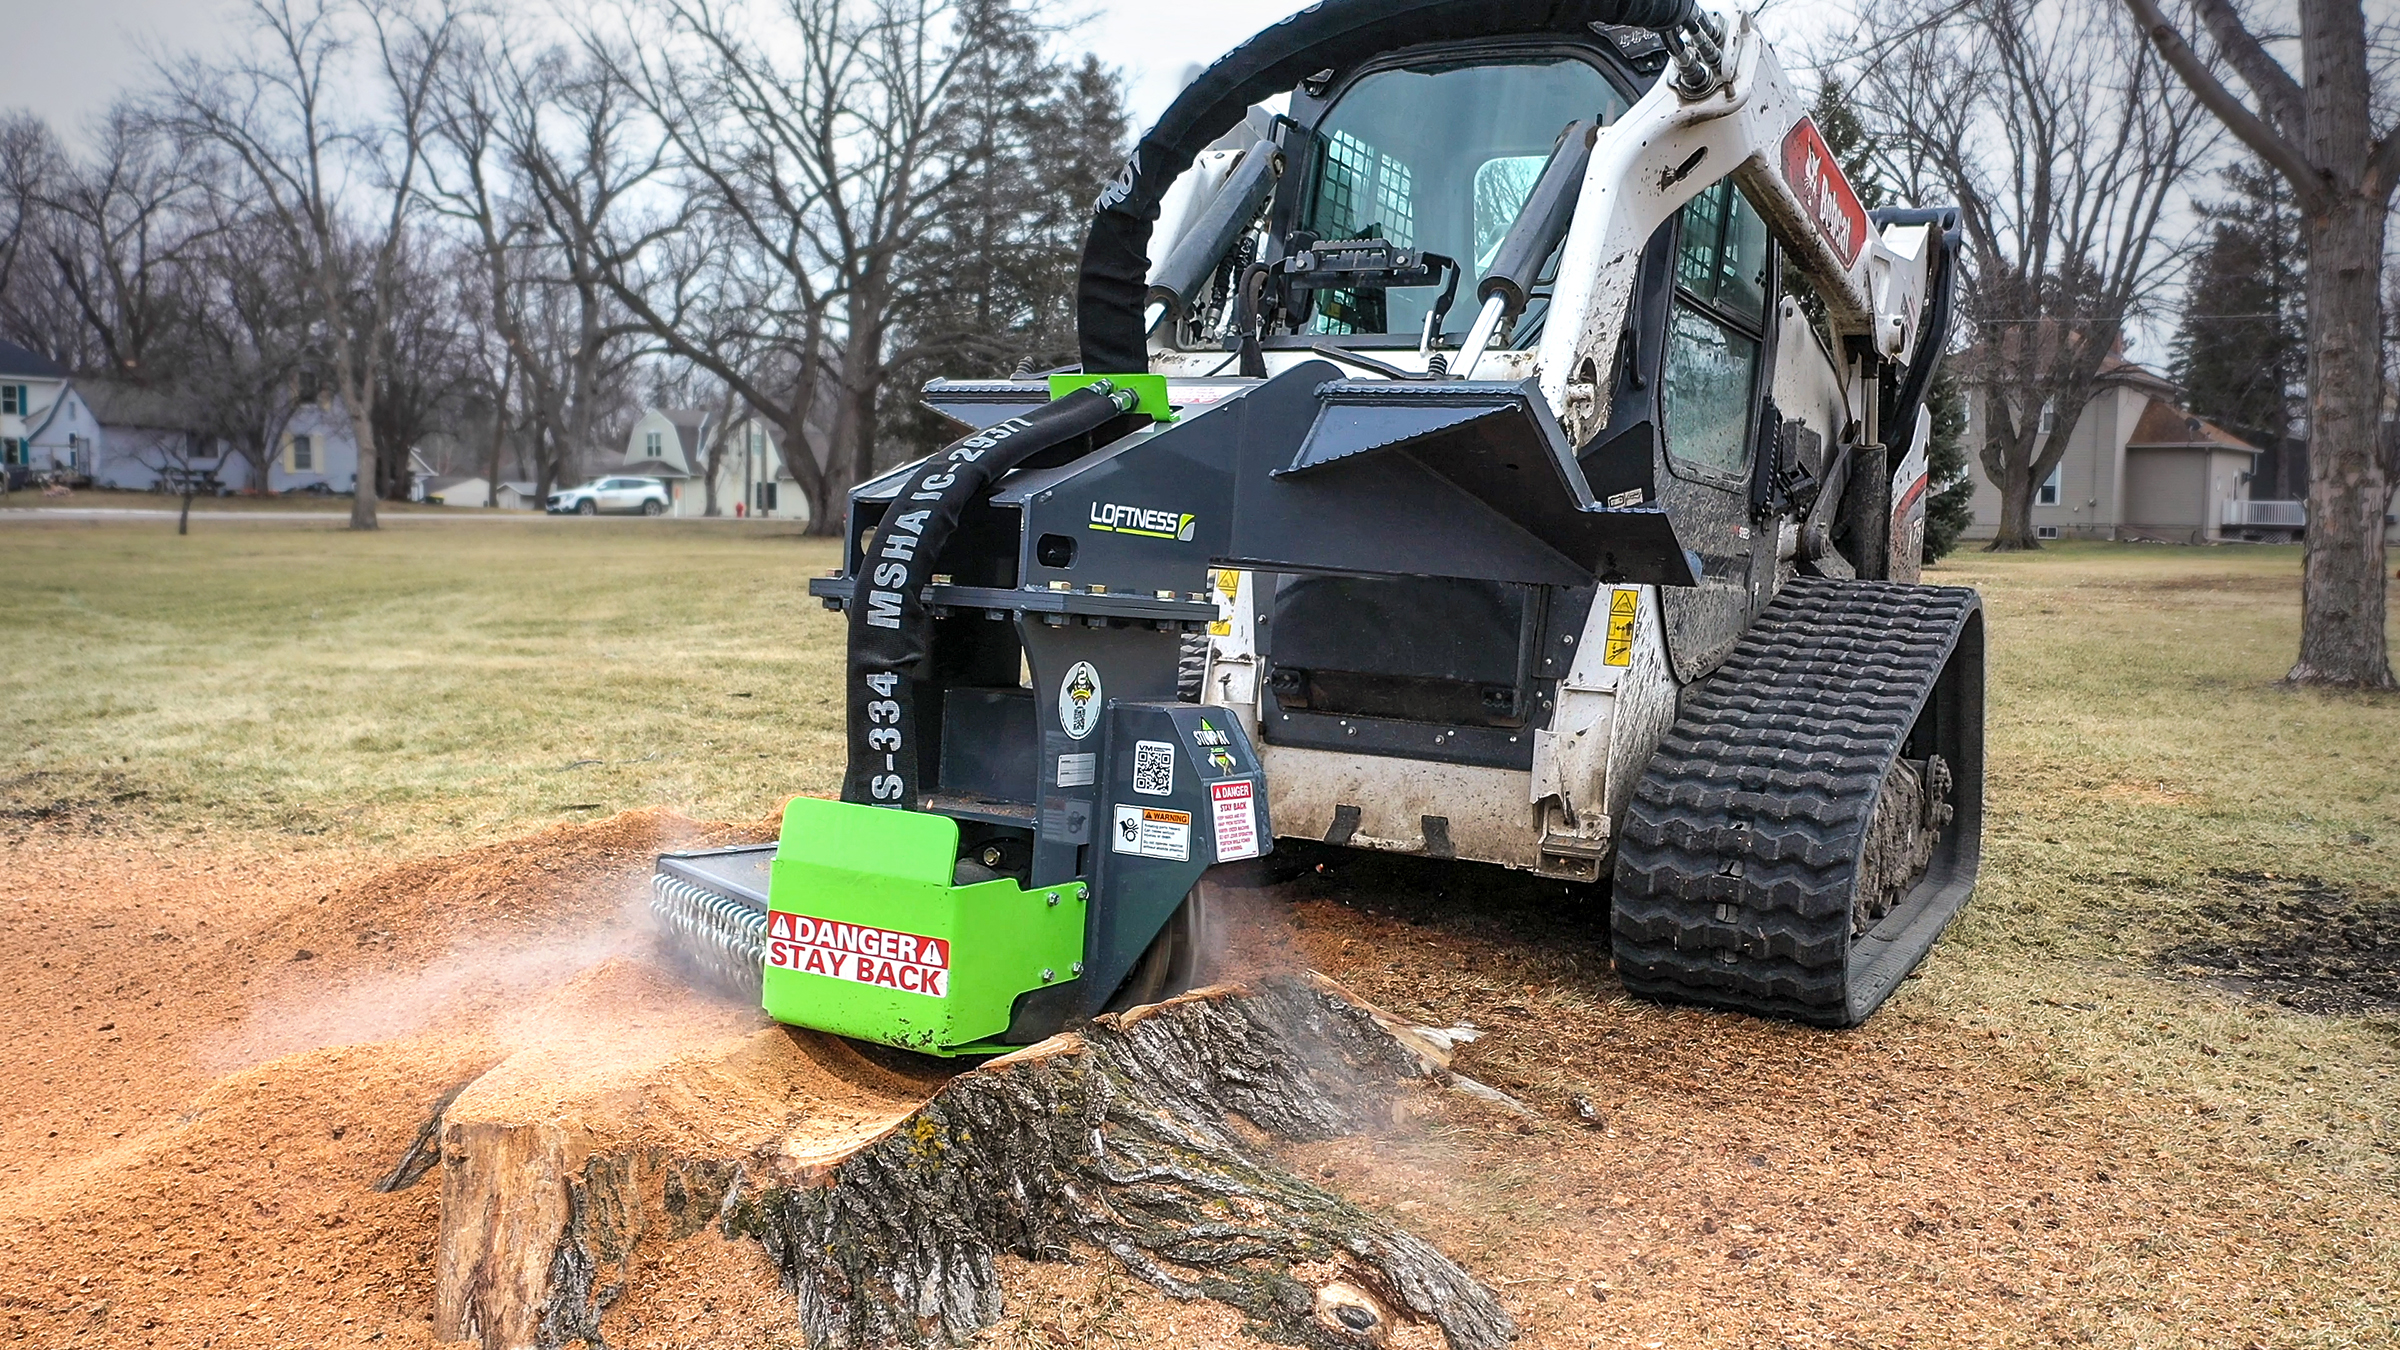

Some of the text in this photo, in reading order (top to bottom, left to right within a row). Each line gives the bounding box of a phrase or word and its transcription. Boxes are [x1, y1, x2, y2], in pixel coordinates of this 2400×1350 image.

[1819, 173, 1850, 259] Bobcat
[1090, 501, 1179, 532] LOFTNESS
[867, 509, 932, 630] MSHA
[866, 671, 904, 810] S-334
[1220, 801, 1247, 813] STAY BACK
[1221, 785, 1250, 799] DANGER
[1153, 812, 1188, 823] WARNING
[794, 915, 919, 963] DANGER
[770, 941, 942, 996] STAY BACK
